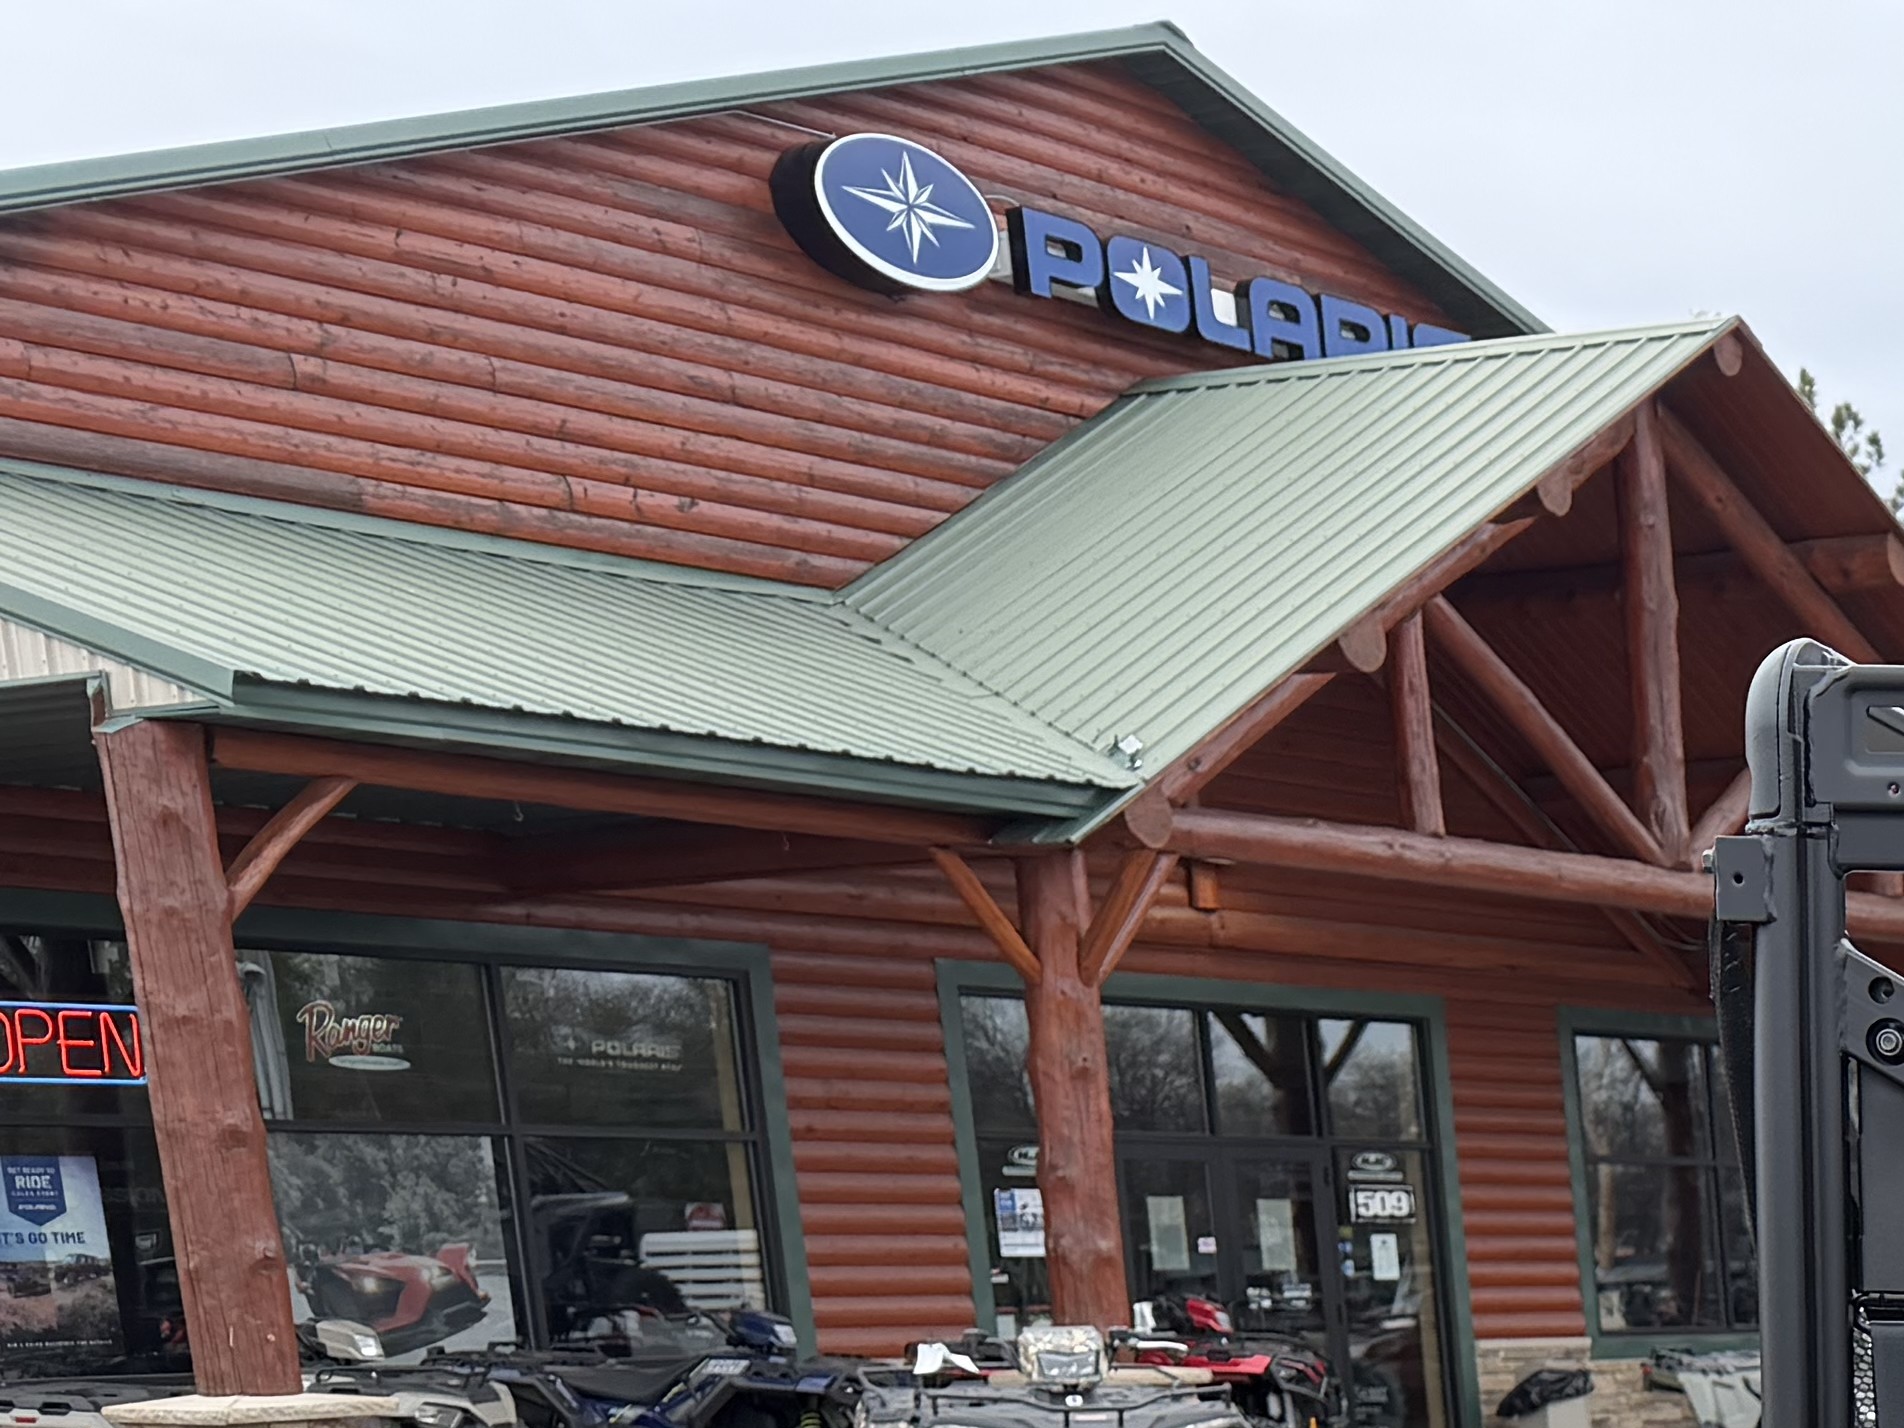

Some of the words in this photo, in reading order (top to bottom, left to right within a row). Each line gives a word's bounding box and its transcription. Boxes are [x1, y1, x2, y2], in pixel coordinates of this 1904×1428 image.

[296, 1000, 401, 1062] Ranger
[591, 1040, 681, 1059] POLARIS
[14, 1174, 52, 1190] RIDE
[1356, 1190, 1410, 1217] 509
[0, 1231, 24, 1245] T'S
[28, 1231, 48, 1245] GO
[51, 1231, 86, 1245] TIME
